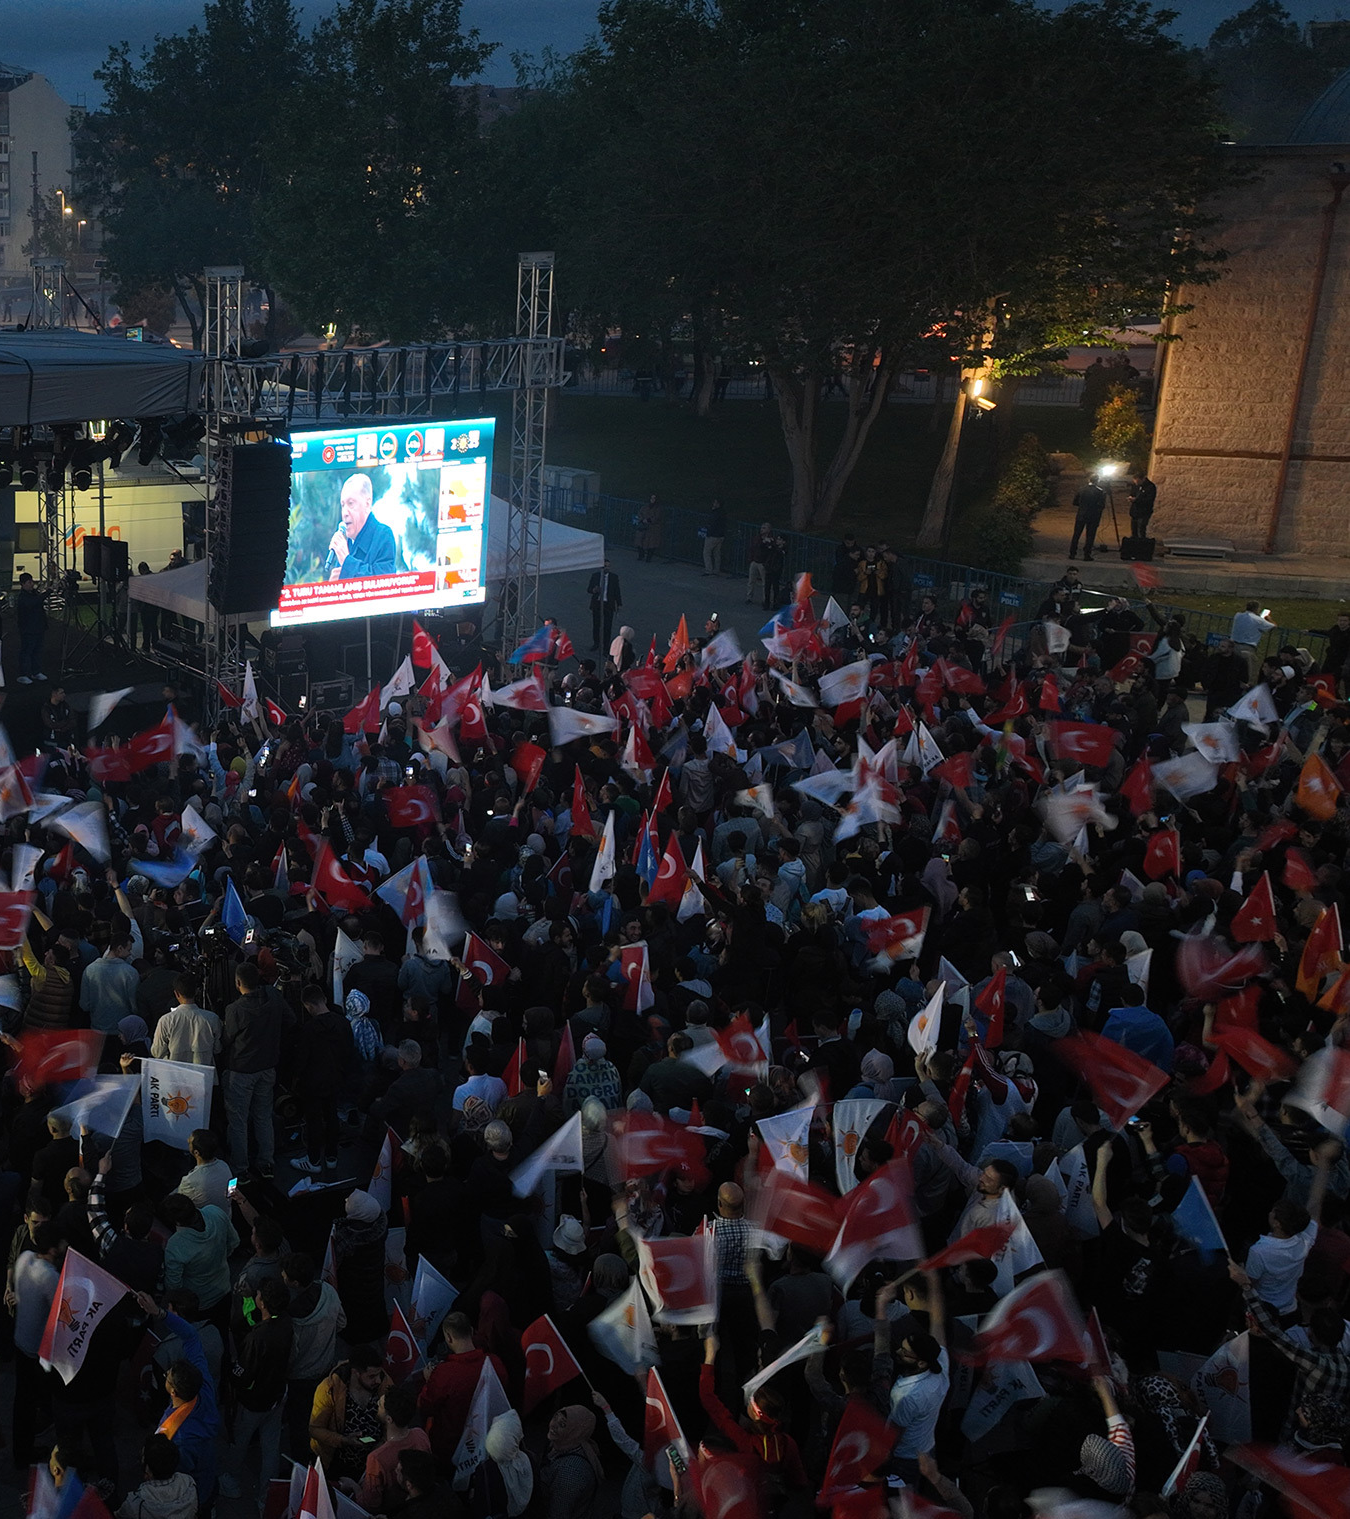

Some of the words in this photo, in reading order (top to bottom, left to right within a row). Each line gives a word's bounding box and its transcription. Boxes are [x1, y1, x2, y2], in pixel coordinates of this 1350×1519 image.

[575, 1061, 615, 1073] OĞRU
[150, 1076, 160, 1090] AK
[566, 1071, 620, 1085] ZAMAN
[567, 1082, 621, 1098] DOĞRU
[1078, 1162, 1087, 1178] AK
